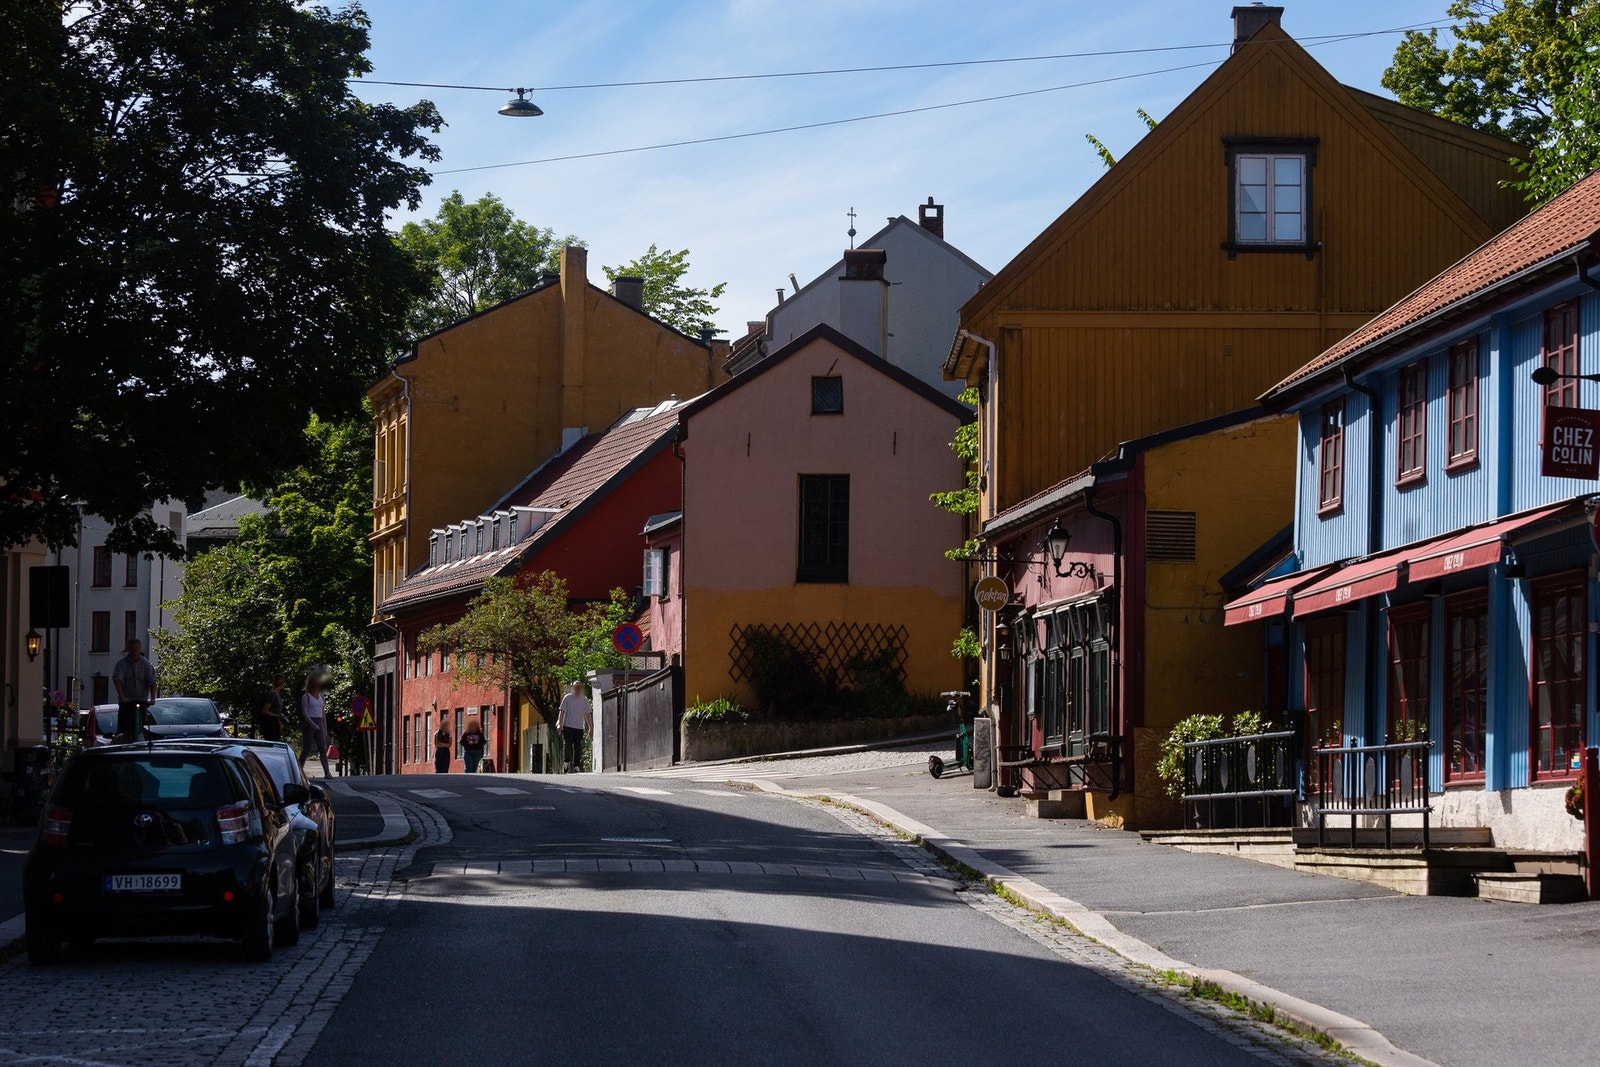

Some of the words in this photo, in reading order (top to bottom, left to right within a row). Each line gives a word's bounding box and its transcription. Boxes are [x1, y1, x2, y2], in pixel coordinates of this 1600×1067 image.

[1553, 426, 1594, 448] CHEZ
[1552, 446, 1593, 465] COLIN
[115, 876, 133, 889] VH
[140, 875, 178, 888] 18699
